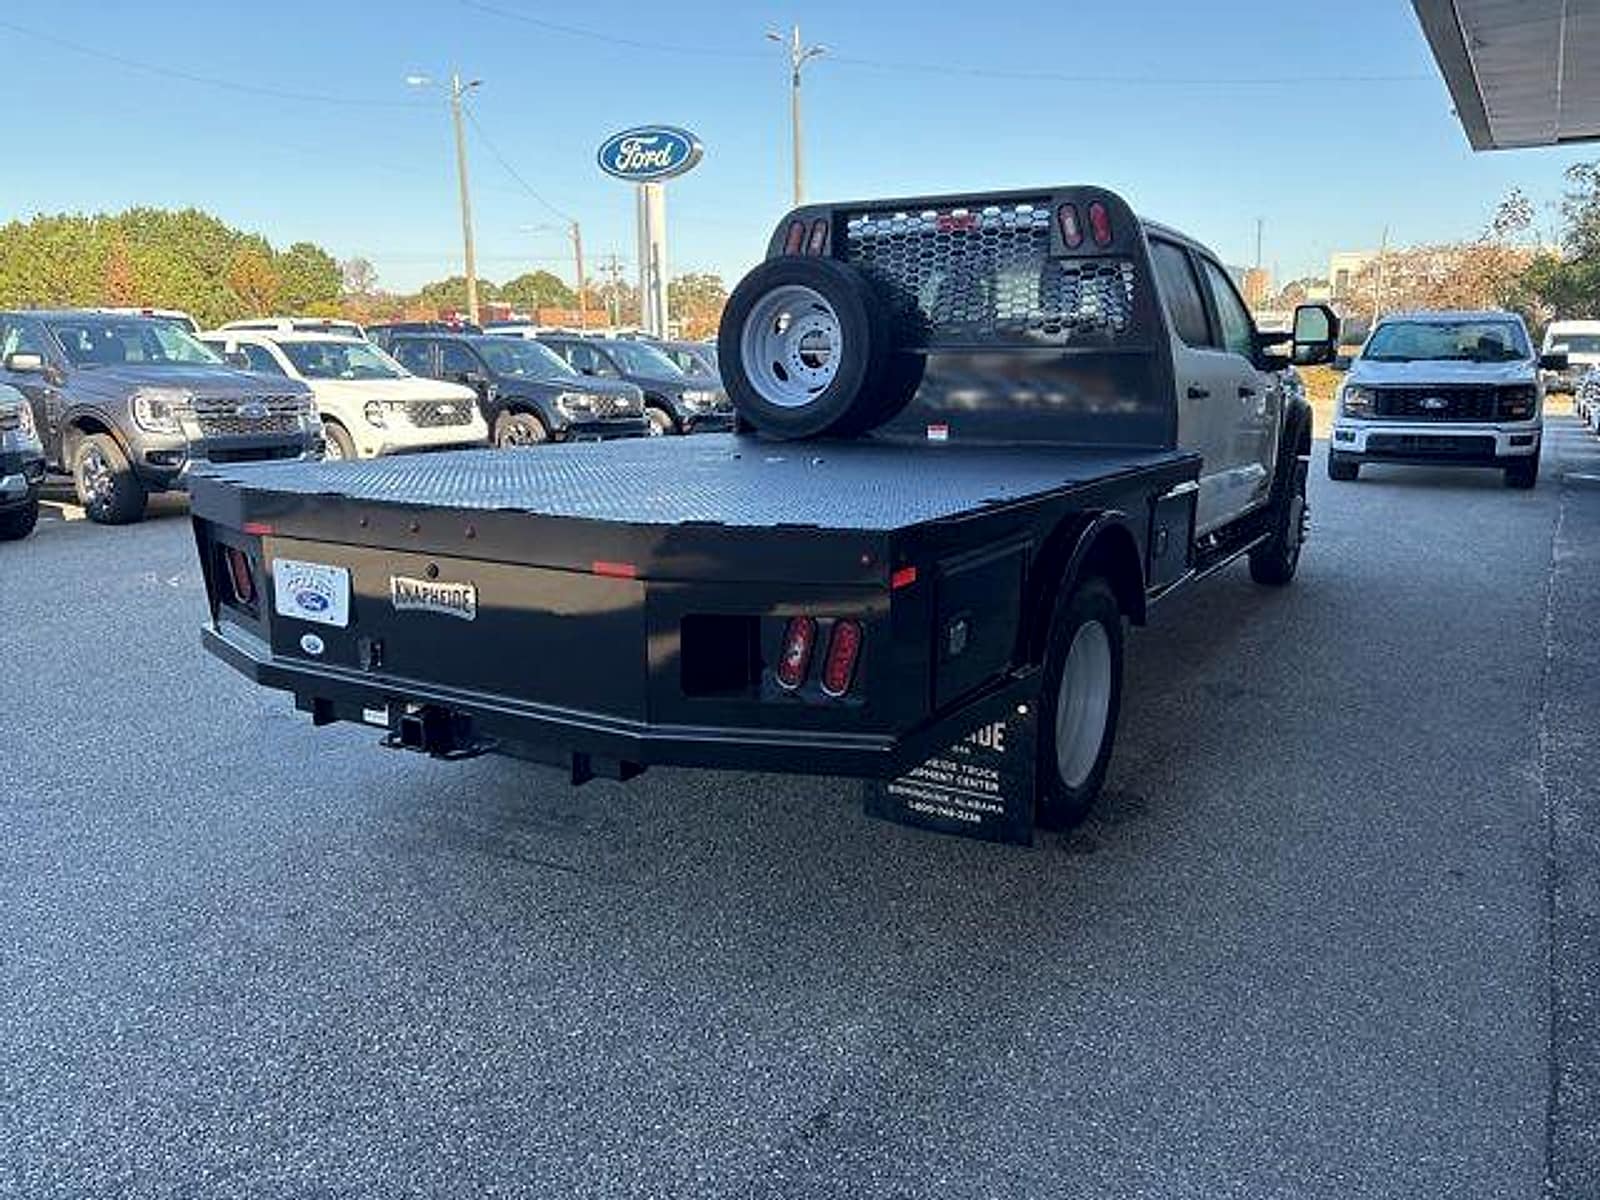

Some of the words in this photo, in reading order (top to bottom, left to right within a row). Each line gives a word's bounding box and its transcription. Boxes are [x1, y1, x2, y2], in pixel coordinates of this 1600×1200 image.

[615, 136, 674, 170] Ford
[395, 579, 471, 613] KNAPHEIDE
[956, 775, 999, 791] CENTER
